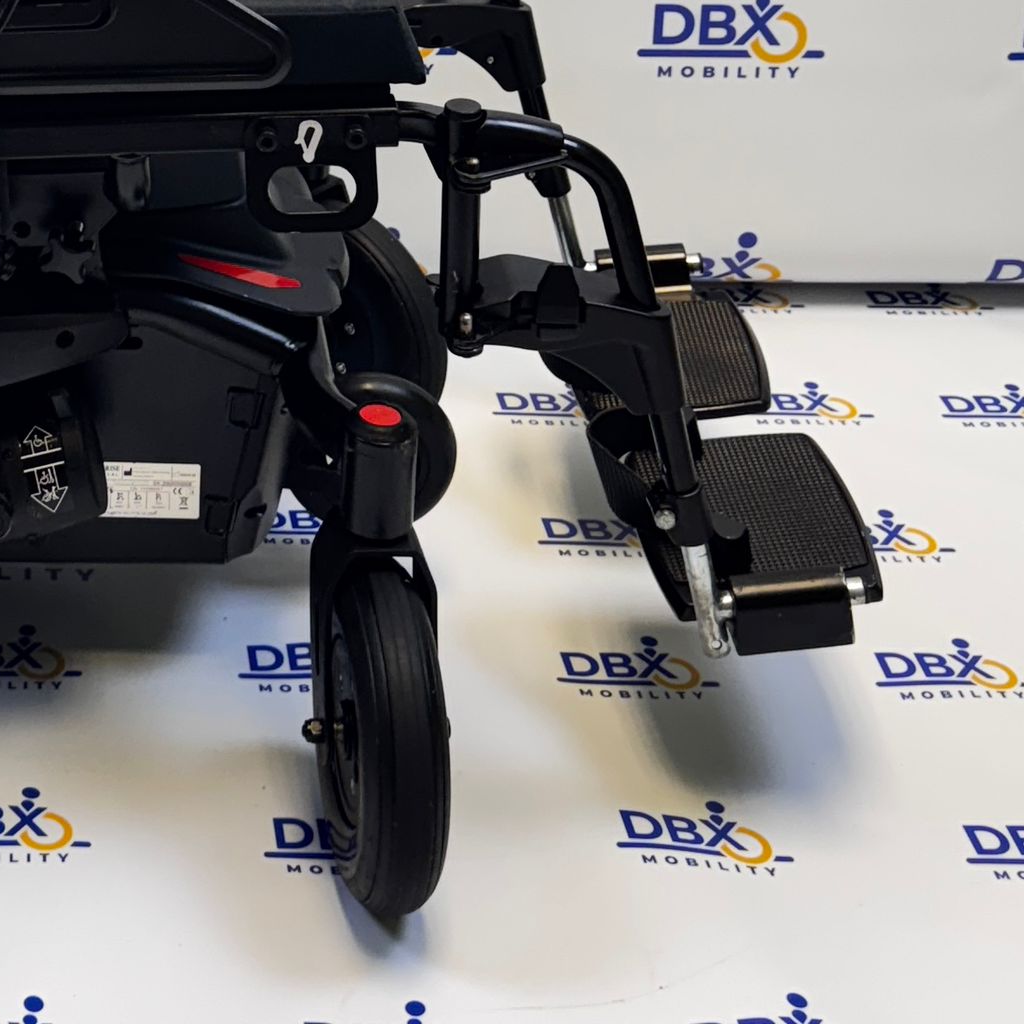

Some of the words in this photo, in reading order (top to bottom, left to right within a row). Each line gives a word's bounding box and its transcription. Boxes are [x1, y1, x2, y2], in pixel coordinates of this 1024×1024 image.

[651, 3, 785, 47] DBX
[656, 65, 801, 80] MOBILITY
[865, 290, 962, 306] DBX
[771, 393, 839, 413] BX
[558, 548, 643, 558] MOBILI
[880, 555, 943, 564] ILITY
[246, 642, 312, 672] DB
[559, 651, 678, 679] DBX
[873, 652, 997, 679] DBX
[578, 688, 703, 700] MOBILITY
[899, 689, 1024, 701] MOBILITY
[618, 809, 749, 851] DBX
[640, 854, 778, 877] MOBILITY
